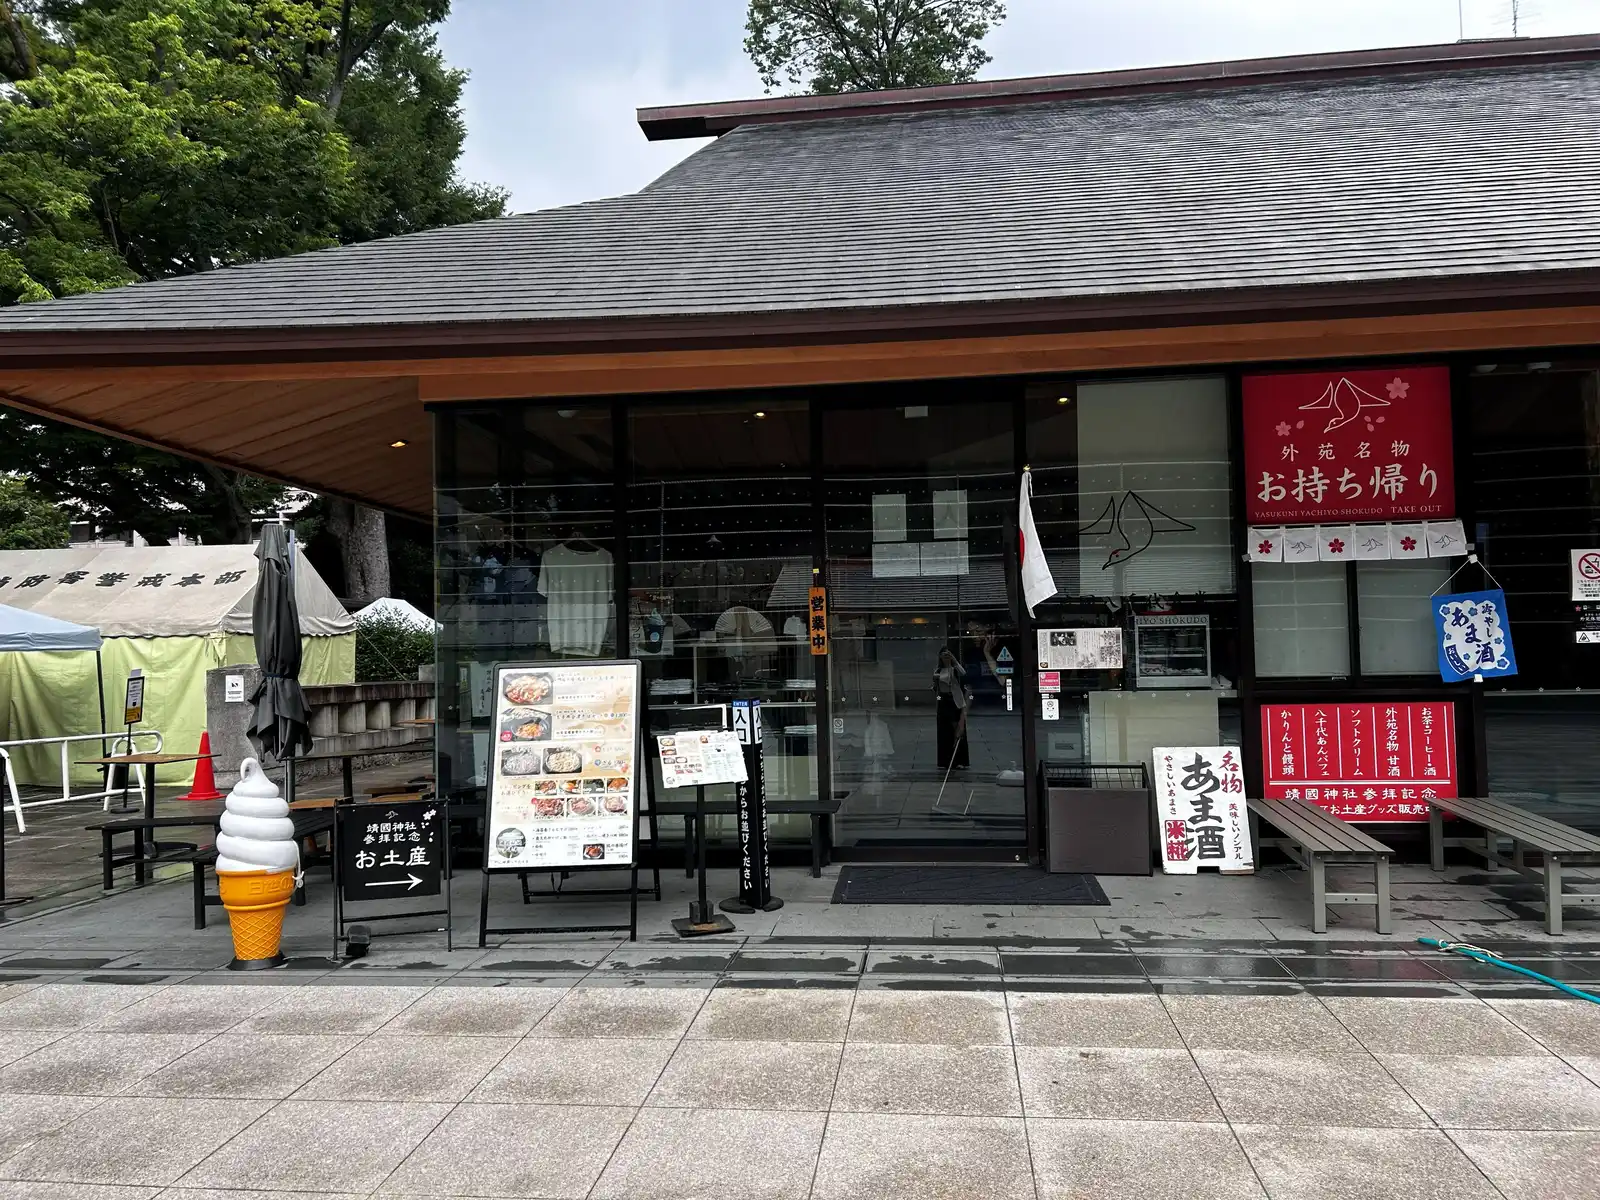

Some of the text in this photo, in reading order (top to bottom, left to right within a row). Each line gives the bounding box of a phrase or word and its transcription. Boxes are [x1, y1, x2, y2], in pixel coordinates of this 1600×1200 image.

[1281, 440, 1410, 462] 外苑名物
[1257, 463, 1438, 504] お持ち帰り
[1255, 504, 1442, 518] YASUKUNI YACHIYO SHOKUDO TAKE OUT
[811, 595, 825, 649] 営業中
[1160, 616, 1208, 625] SHOKUDO
[1451, 606, 1495, 664] あま酒
[1481, 603, 1494, 638] 冷やし
[735, 708, 747, 742] 入口
[1281, 709, 1295, 776] かりんと饅頭
[1314, 709, 1330, 776] 八千代あんパフェ
[1350, 709, 1363, 776] ソフトクリーム
[1385, 707, 1400, 777] 外苑名物 甘酒
[1421, 707, 1436, 776] お茶・コーヒー・酒
[1164, 755, 1177, 815] やさしいあまさ
[1219, 750, 1243, 793] 名物
[366, 821, 417, 834] 靖國神社
[1180, 752, 1226, 860] あま酒
[355, 845, 431, 869] お土産
[739, 781, 752, 890] からお並びください
